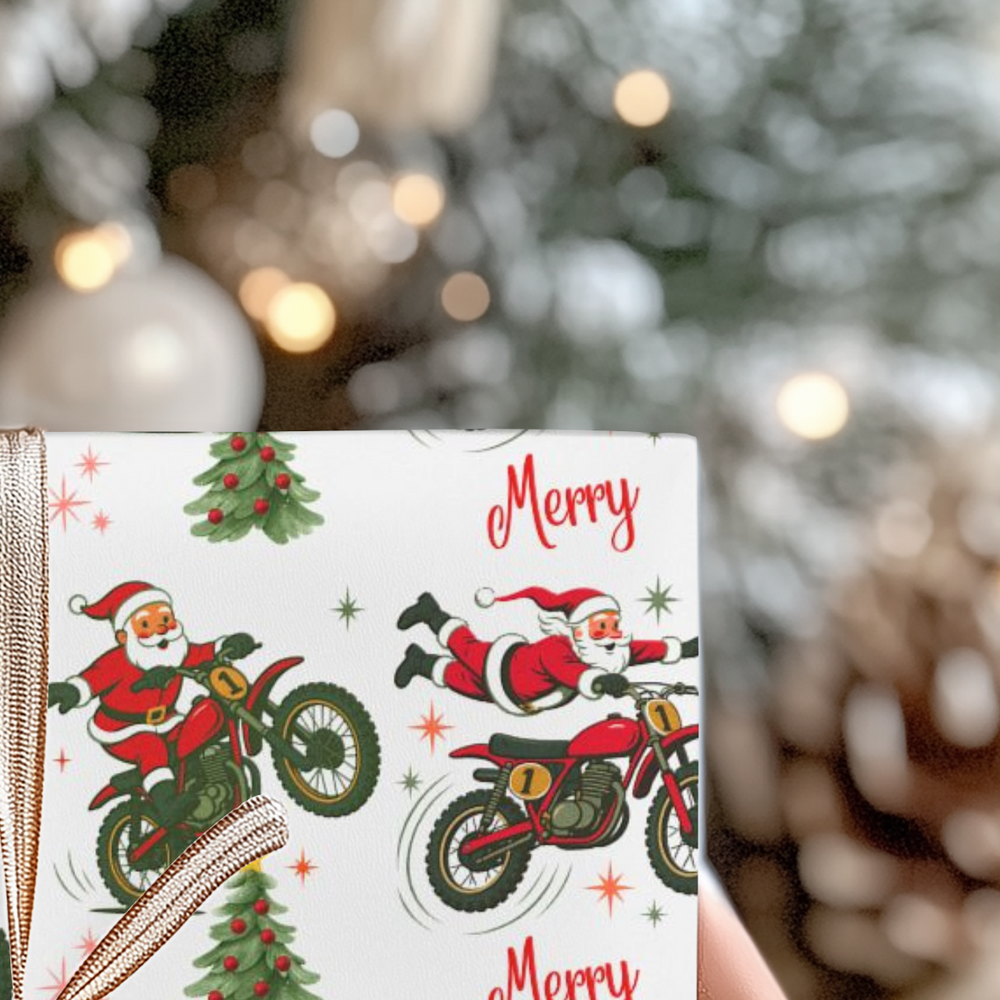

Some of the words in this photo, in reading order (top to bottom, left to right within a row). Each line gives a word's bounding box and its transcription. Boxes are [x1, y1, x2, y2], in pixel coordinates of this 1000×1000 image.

[487, 453, 640, 553] Merry
[218, 671, 243, 695] 1
[655, 704, 672, 732] 1
[522, 767, 535, 795] 1
